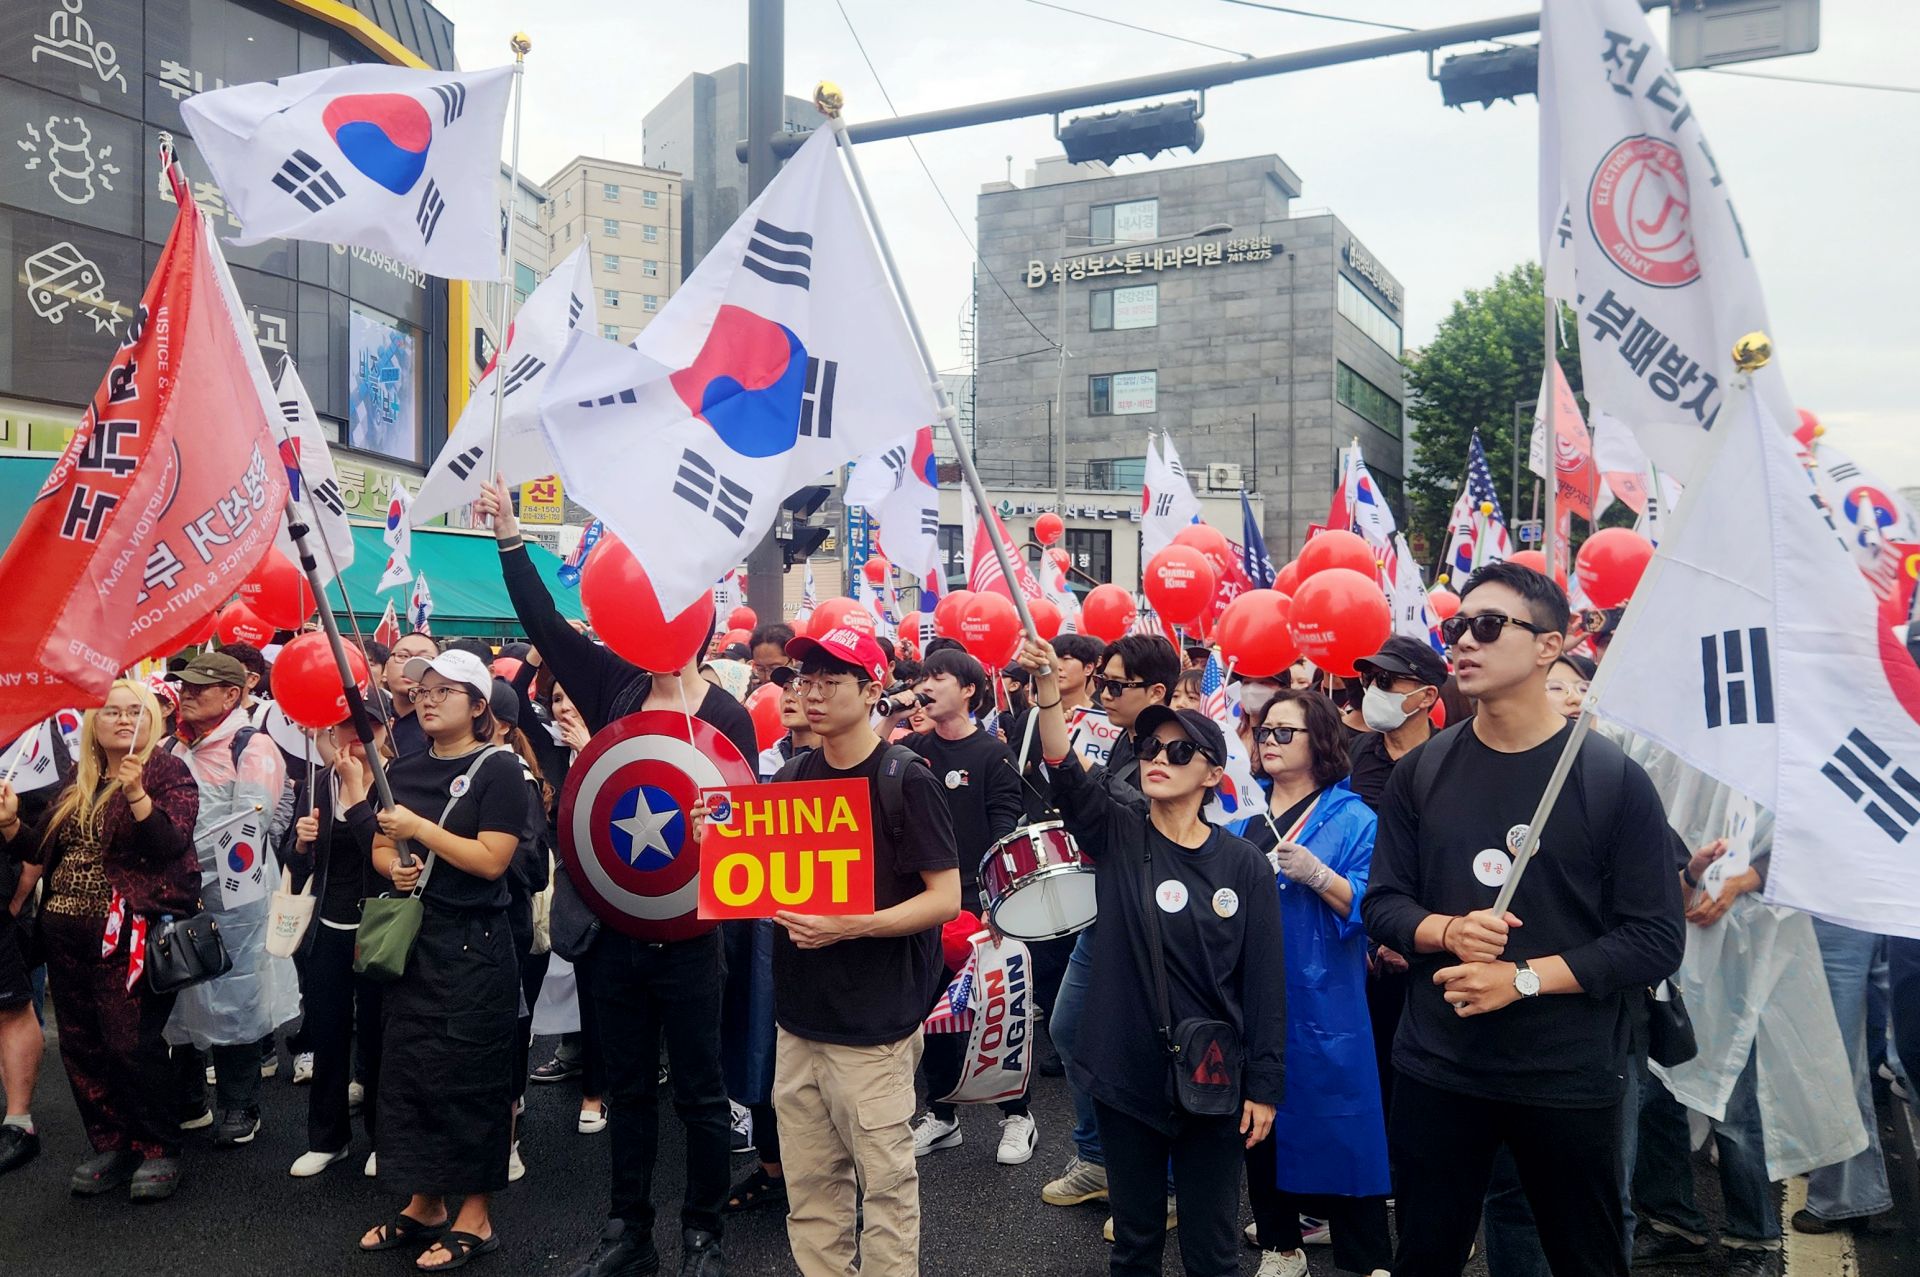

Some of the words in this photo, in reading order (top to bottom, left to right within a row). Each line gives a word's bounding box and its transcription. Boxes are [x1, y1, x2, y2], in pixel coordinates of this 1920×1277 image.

[1050, 241, 1222, 283] 삼성보스톤내과의원
[1226, 235, 1272, 254] 건강검진
[1226, 249, 1273, 266] 741-8275
[1613, 243, 1654, 275] ARMY
[713, 849, 861, 907] OUT
[973, 968, 1006, 1078] YOON
[1002, 953, 1027, 1072] AGAIN
